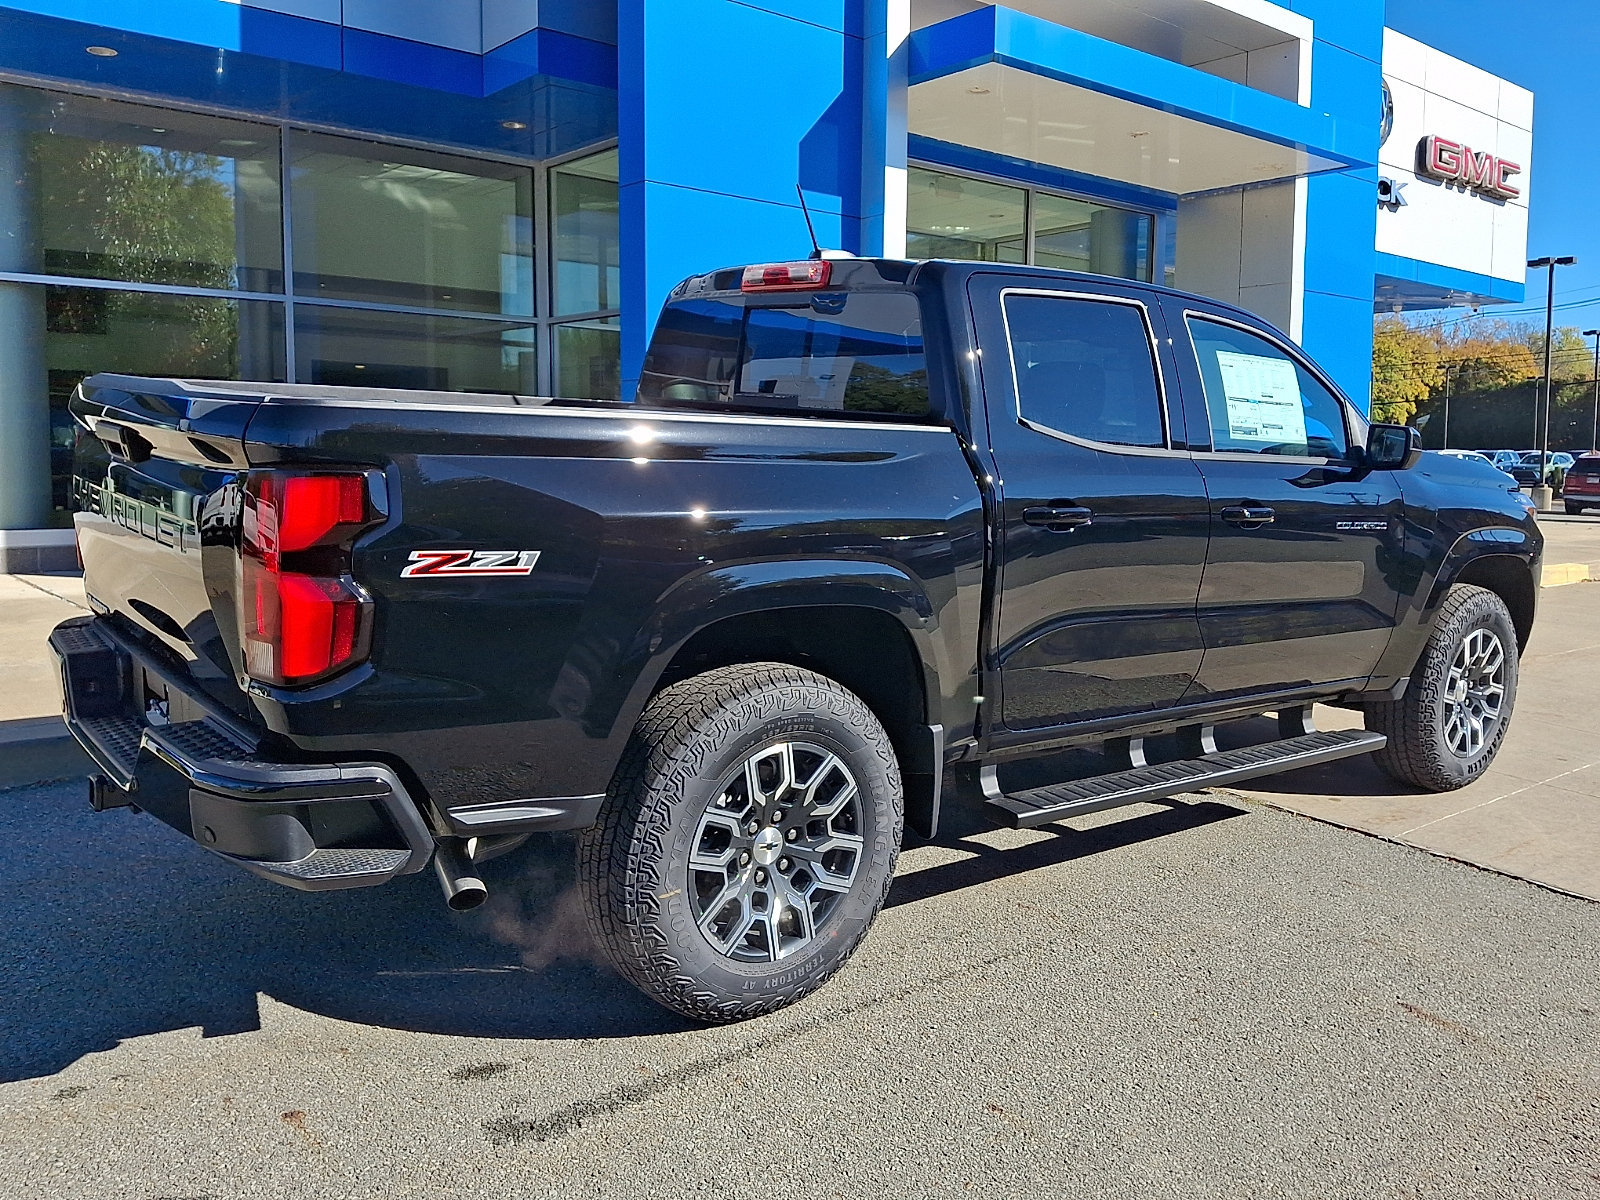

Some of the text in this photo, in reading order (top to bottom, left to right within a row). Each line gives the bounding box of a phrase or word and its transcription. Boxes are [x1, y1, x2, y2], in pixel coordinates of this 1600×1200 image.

[1424, 135, 1521, 199] GMC
[73, 474, 196, 554] CHEVROLET
[401, 550, 541, 577] Z71
[1467, 716, 1508, 774] WRANGLER
[742, 954, 825, 990] TERRITORY AT
